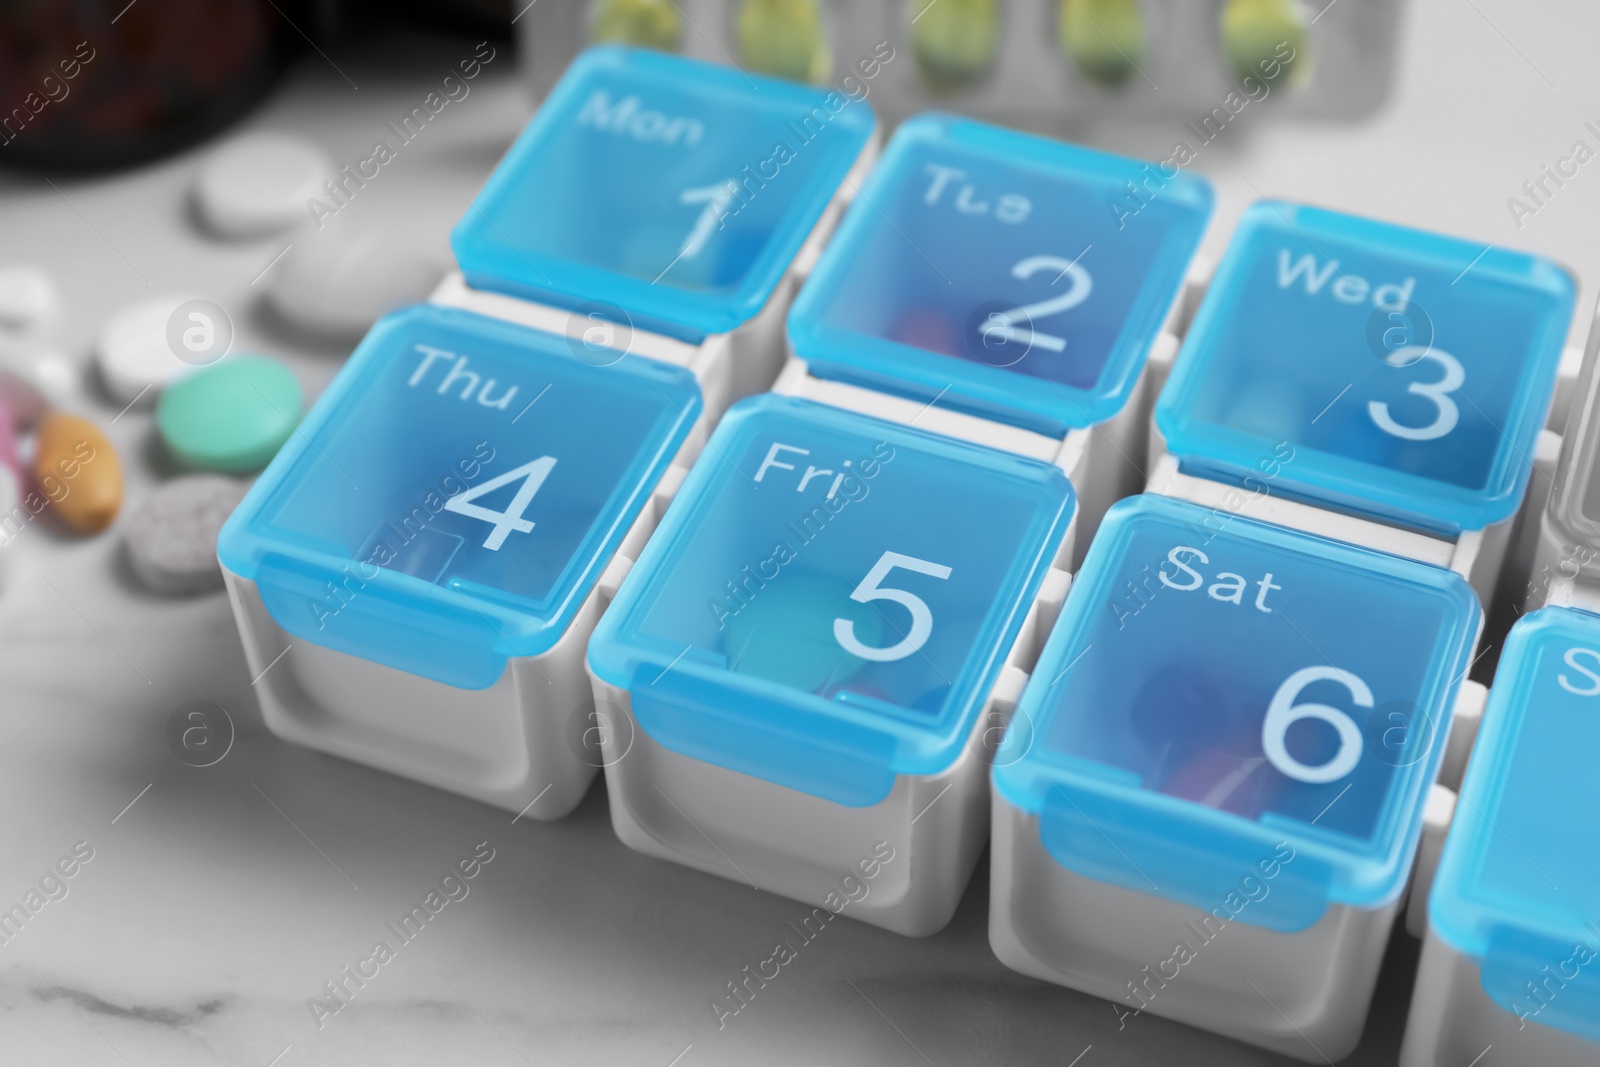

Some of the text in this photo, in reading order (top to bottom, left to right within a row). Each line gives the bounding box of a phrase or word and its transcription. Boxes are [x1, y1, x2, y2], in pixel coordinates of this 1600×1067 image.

[577, 88, 706, 148] Mon
[678, 179, 741, 261] 1
[977, 254, 1094, 354] 2
[1276, 248, 1417, 313] Wed
[407, 343, 520, 411] Thu
[1367, 345, 1466, 441] 3
[443, 455, 558, 552] 4
[753, 441, 853, 500] Fri
[832, 550, 953, 663] 5
[1158, 545, 1282, 614] Sat
[1261, 665, 1375, 784] 6
